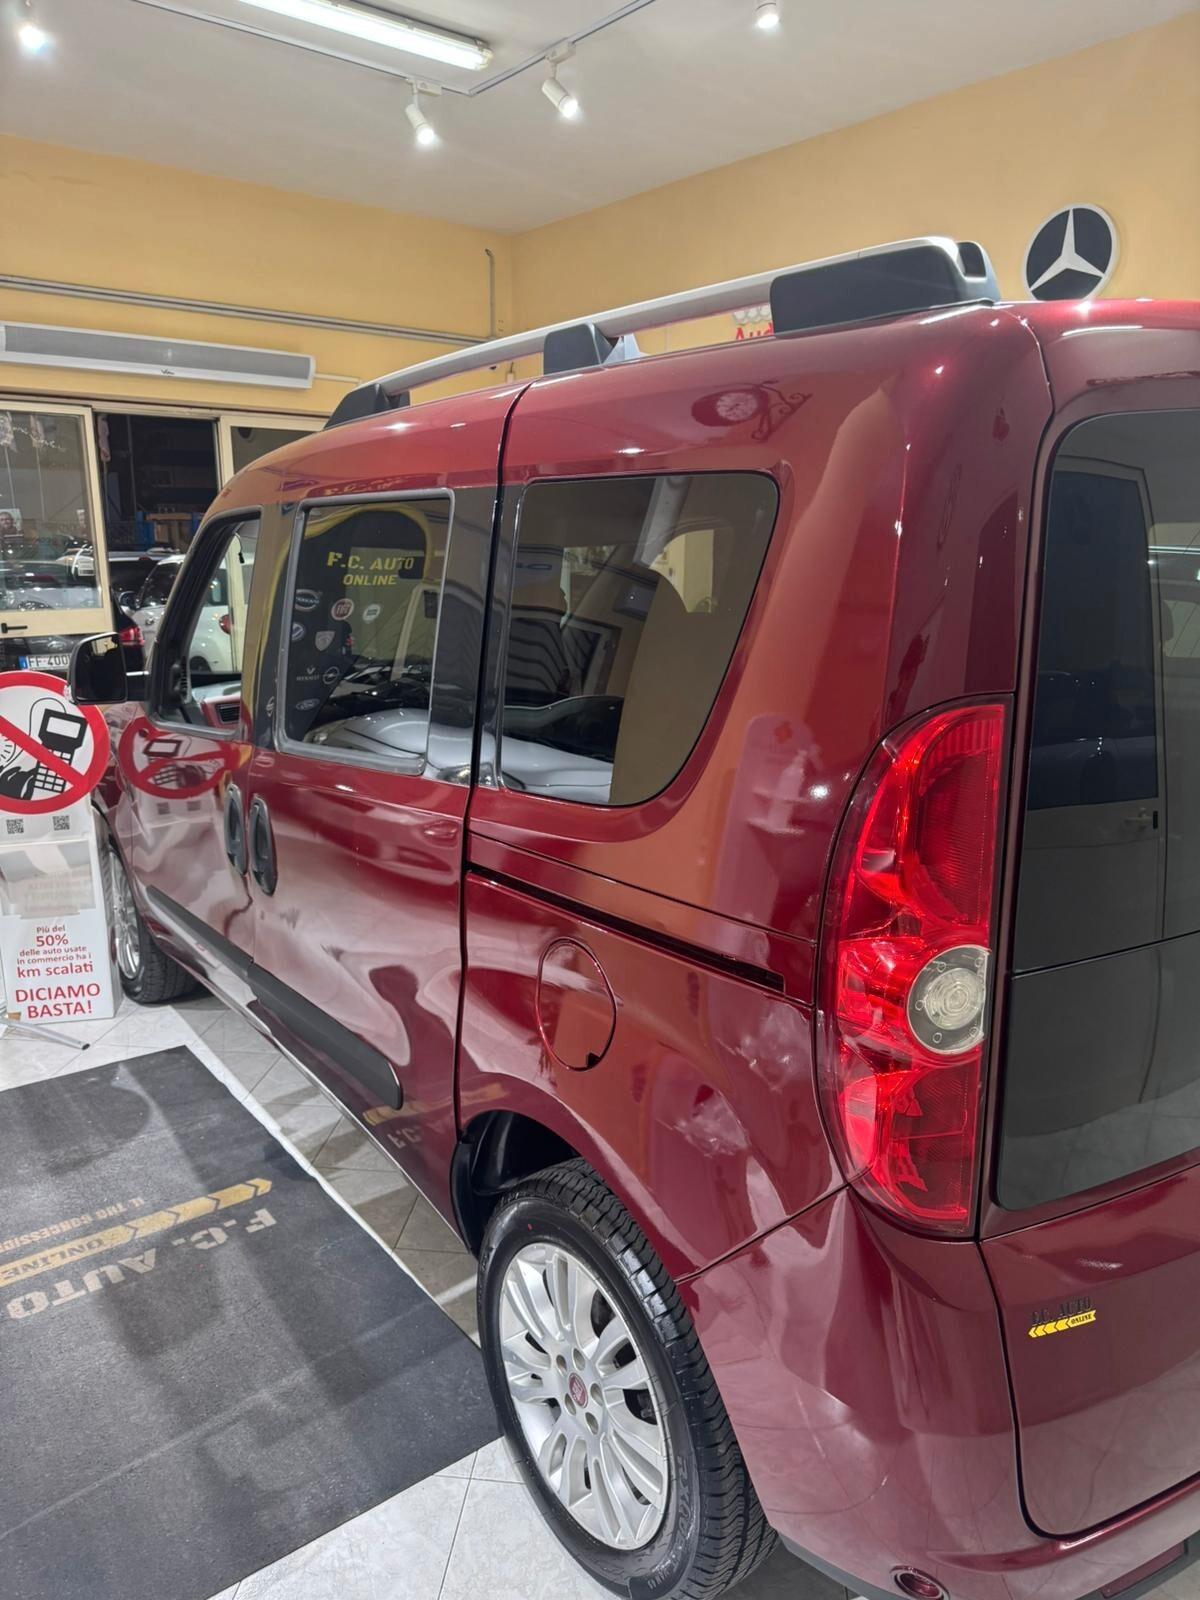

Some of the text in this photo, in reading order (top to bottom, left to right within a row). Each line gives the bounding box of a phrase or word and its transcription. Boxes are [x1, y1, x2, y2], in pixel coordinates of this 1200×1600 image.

[736, 321, 775, 340] Aud
[326, 551, 415, 571] F.C. AUTO
[342, 574, 398, 586] ONLINE
[36, 924, 66, 934] Più del
[36, 933, 69, 948] 50%
[19, 945, 87, 958] delle auto usate
[27, 953, 74, 965] commercio
[76, 952, 87, 961] ha
[17, 961, 93, 979] km scalati
[15, 983, 101, 1003] DICIAMO
[27, 1000, 92, 1020] BASTA!
[0, 1214, 93, 1251] CONCESSIO
[1, 1238, 105, 1280] ONLINE
[6, 1208, 278, 1319] F.C. AUTO
[1070, 1313, 1093, 1325] ONLINE
